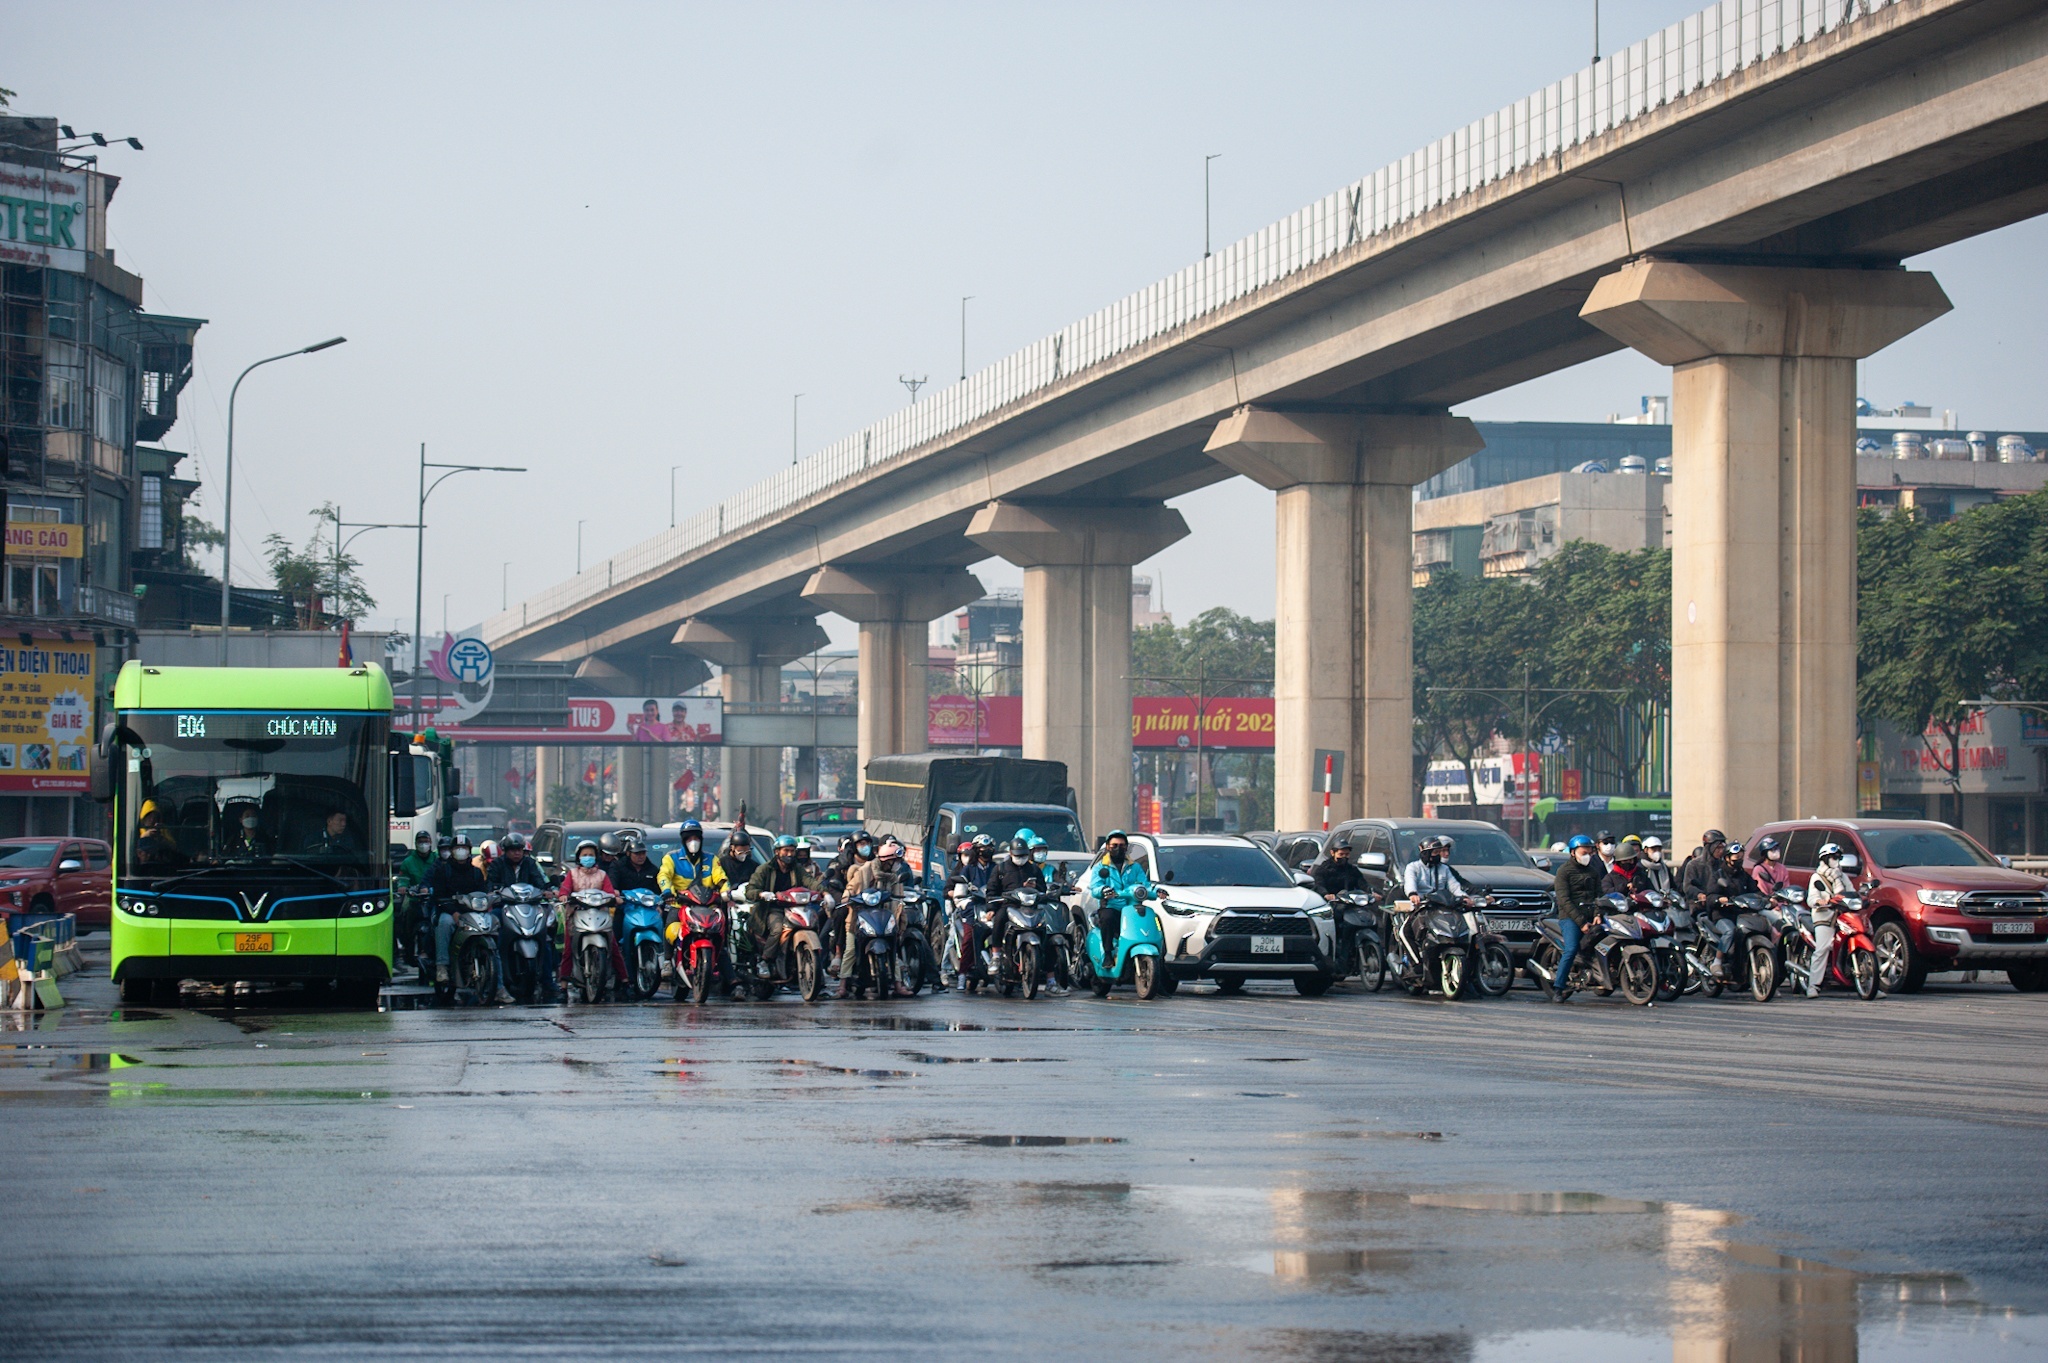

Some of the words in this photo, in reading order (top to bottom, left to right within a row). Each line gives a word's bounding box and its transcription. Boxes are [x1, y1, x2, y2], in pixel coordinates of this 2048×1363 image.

[39, 528, 68, 547] CÁO
[18, 646, 50, 678] ĐIỆN
[53, 652, 90, 679] THOẠI
[52, 711, 67, 728] GIÁ
[70, 709, 82, 728] RẺ
[177, 715, 206, 737] E04
[267, 715, 300, 736] CHÚC
[571, 707, 600, 727] TW3
[1145, 708, 1189, 731] năm
[1193, 708, 1232, 731] mới
[1236, 713, 1275, 732] 202
[1902, 749, 1918, 771] TP
[1969, 746, 2007, 769] MINH
[239, 942, 269, 951] 020.40
[246, 934, 262, 943] 29F
[1254, 944, 1280, 953] 284.44
